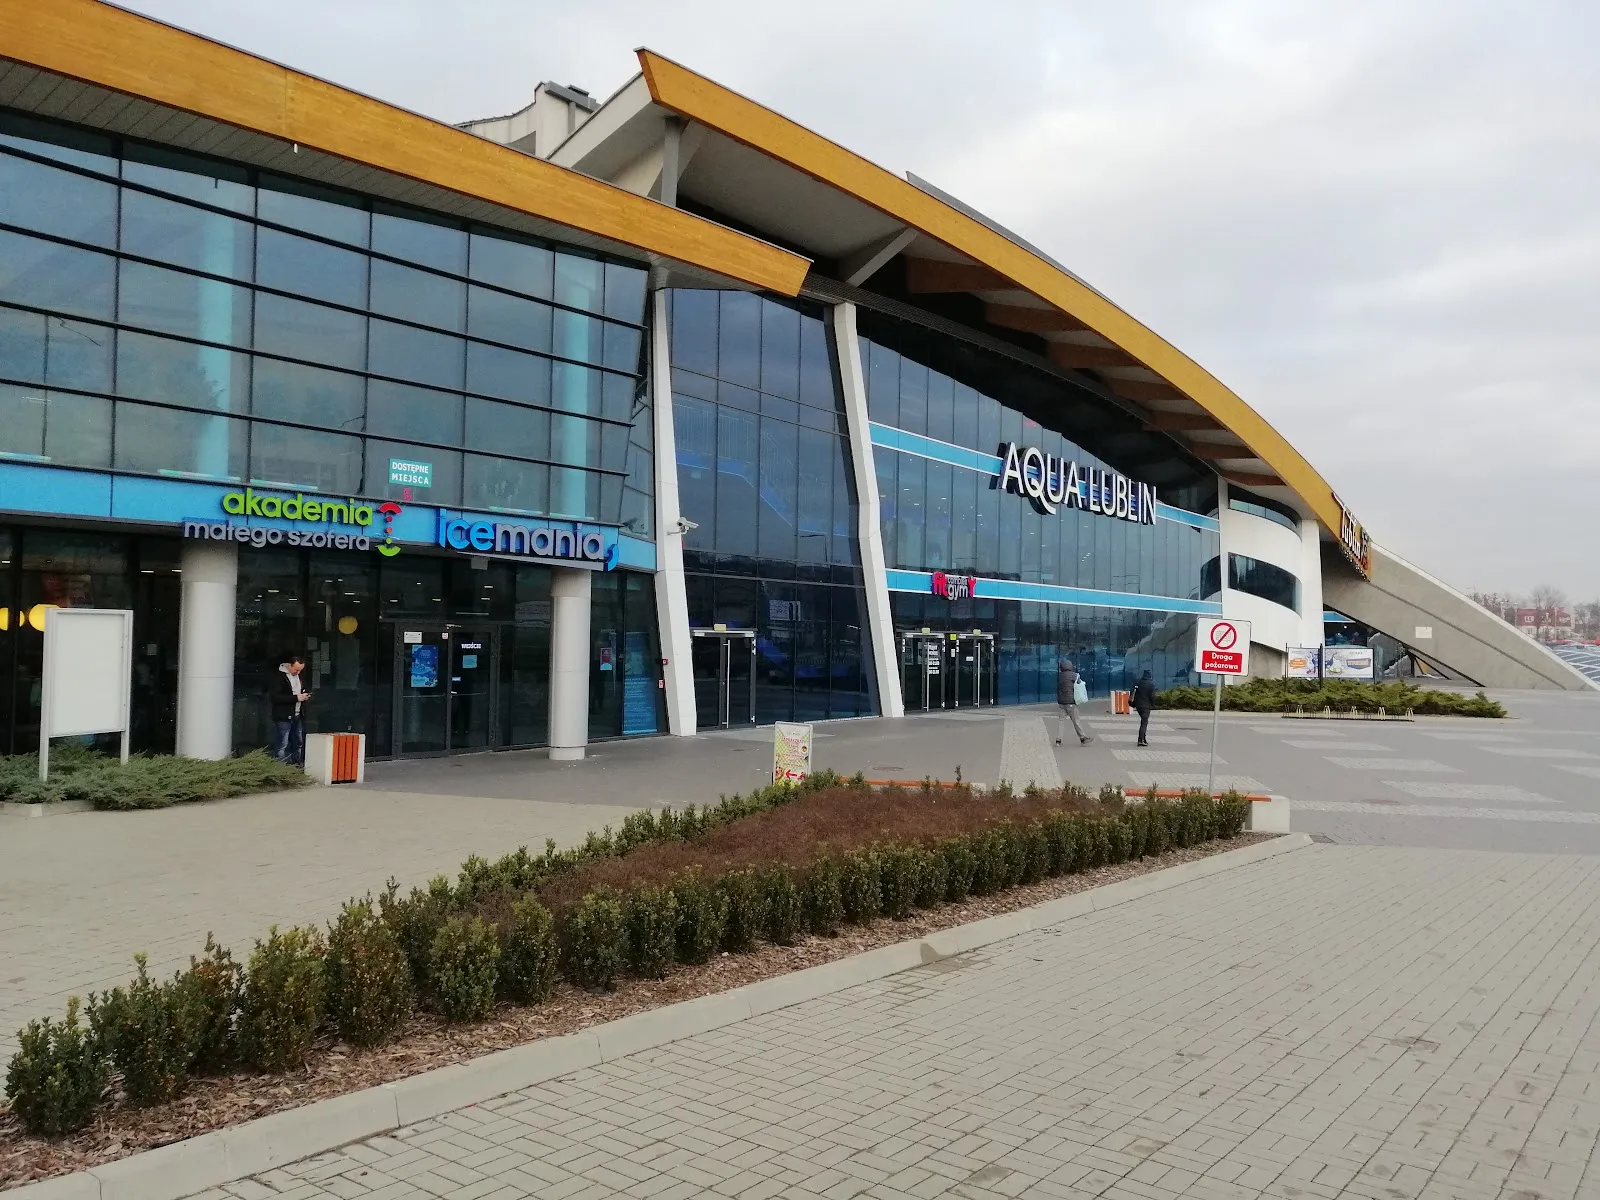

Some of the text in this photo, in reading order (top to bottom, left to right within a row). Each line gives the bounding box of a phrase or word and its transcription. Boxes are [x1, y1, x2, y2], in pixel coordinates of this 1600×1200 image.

[391, 461, 429, 474] DOSTĘPNE
[391, 472, 429, 485] MIEJSCA
[1001, 441, 1157, 526] AQUA LUBLIN
[222, 487, 373, 527] akademia
[183, 520, 370, 551] małego szofera
[436, 507, 604, 561] icemania
[947, 584, 968, 600] gym
[1211, 652, 1233, 662] Droga
[1205, 661, 1239, 670] pożarowa
